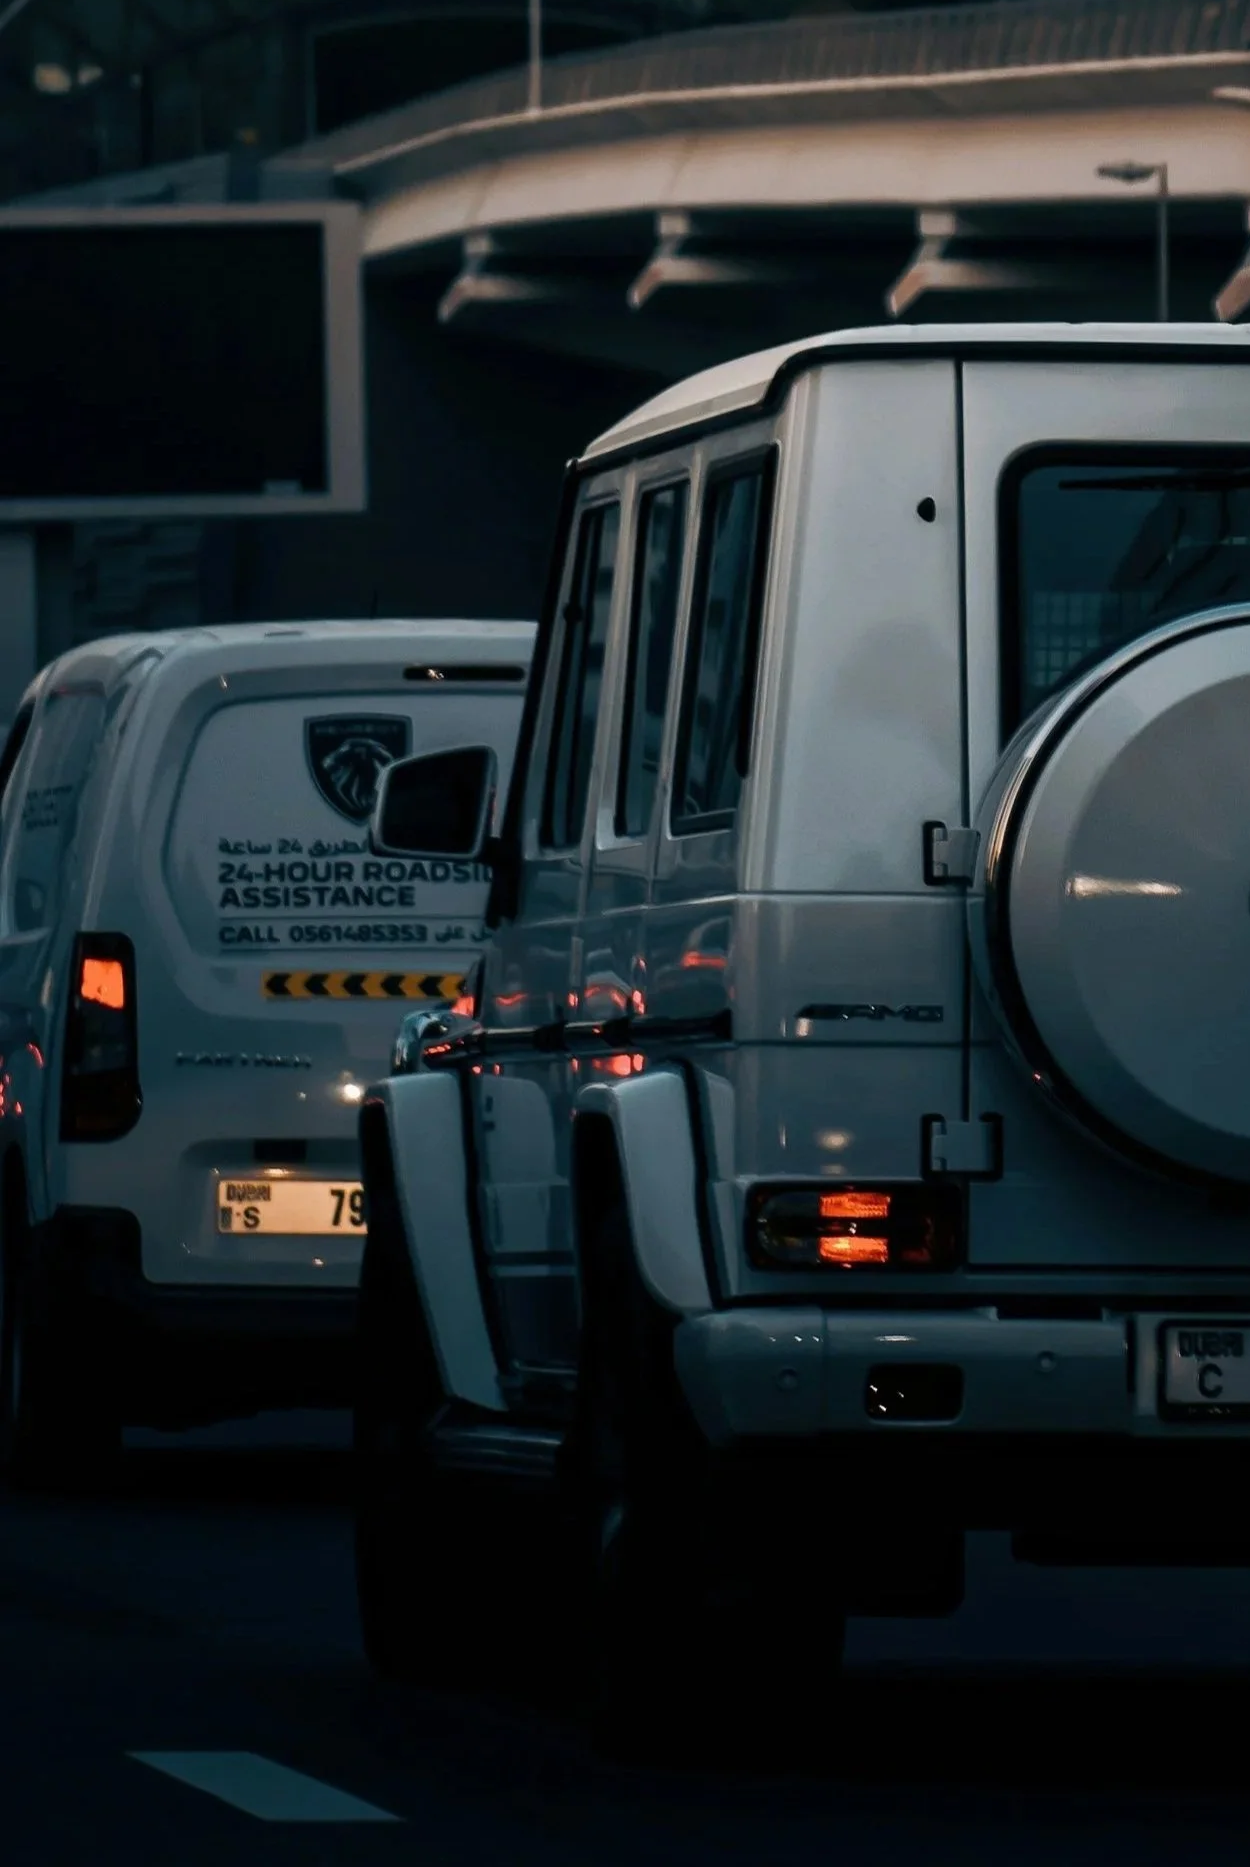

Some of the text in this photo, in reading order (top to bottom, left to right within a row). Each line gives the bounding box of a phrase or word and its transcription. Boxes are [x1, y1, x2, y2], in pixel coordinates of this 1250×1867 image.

[308, 838, 368, 857] لطريق
[218, 861, 354, 883] 24-HOUR
[219, 885, 415, 908] ASSISTANCE
[219, 925, 280, 943] CALL
[243, 1206, 260, 1229] S
[1199, 1363, 1223, 1398] C
